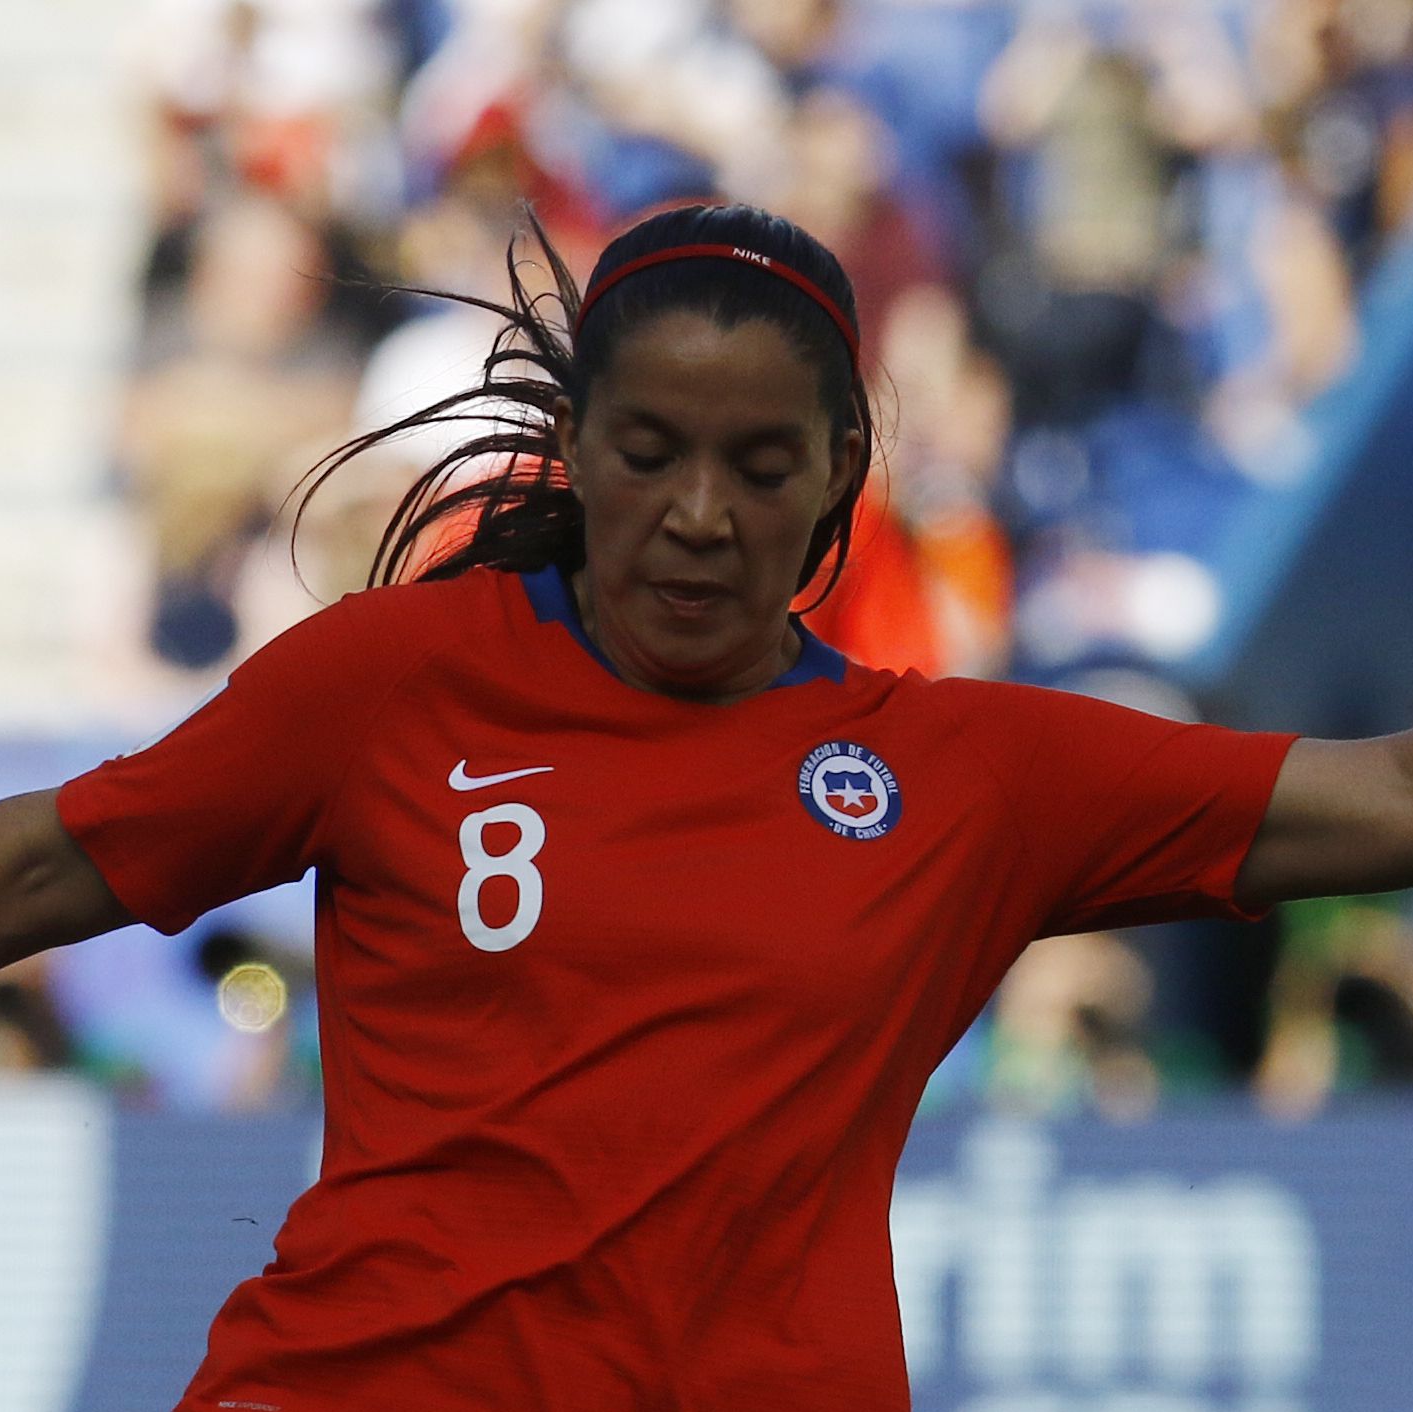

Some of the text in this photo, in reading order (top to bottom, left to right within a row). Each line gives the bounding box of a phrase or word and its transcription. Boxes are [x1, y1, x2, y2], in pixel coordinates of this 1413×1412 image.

[733, 247, 772, 267] NIKE
[798, 742, 899, 795] FEDERACION DE FUTBOL
[833, 822, 886, 839] DE CHILE
[457, 802, 546, 953] 8
